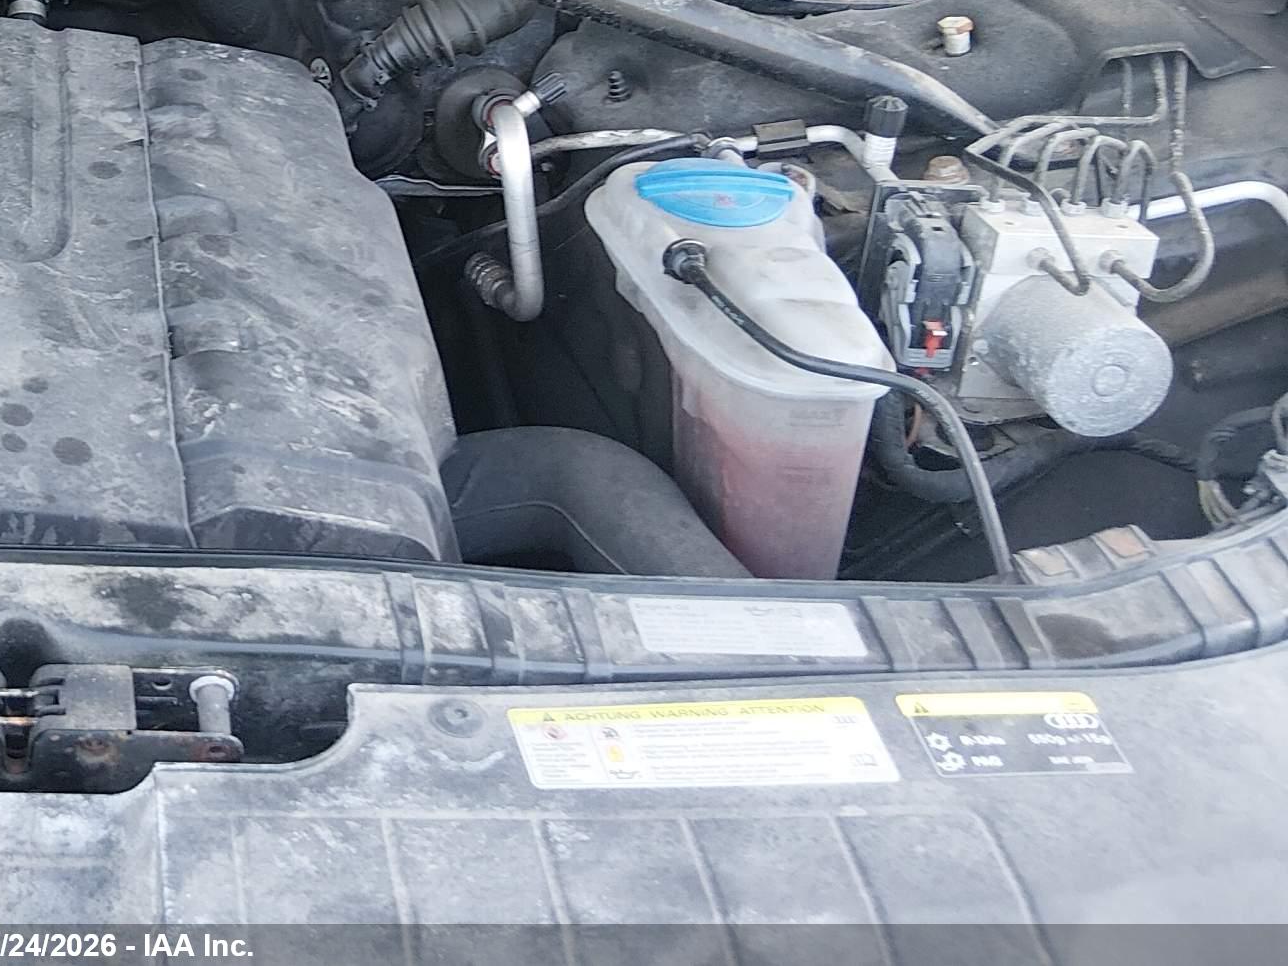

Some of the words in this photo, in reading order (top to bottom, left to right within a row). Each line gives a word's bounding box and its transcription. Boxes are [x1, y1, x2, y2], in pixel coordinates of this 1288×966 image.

[564, 710, 641, 721] ACHTUNG
[649, 707, 729, 718] WARNING
[739, 703, 826, 715] ATTENTION
